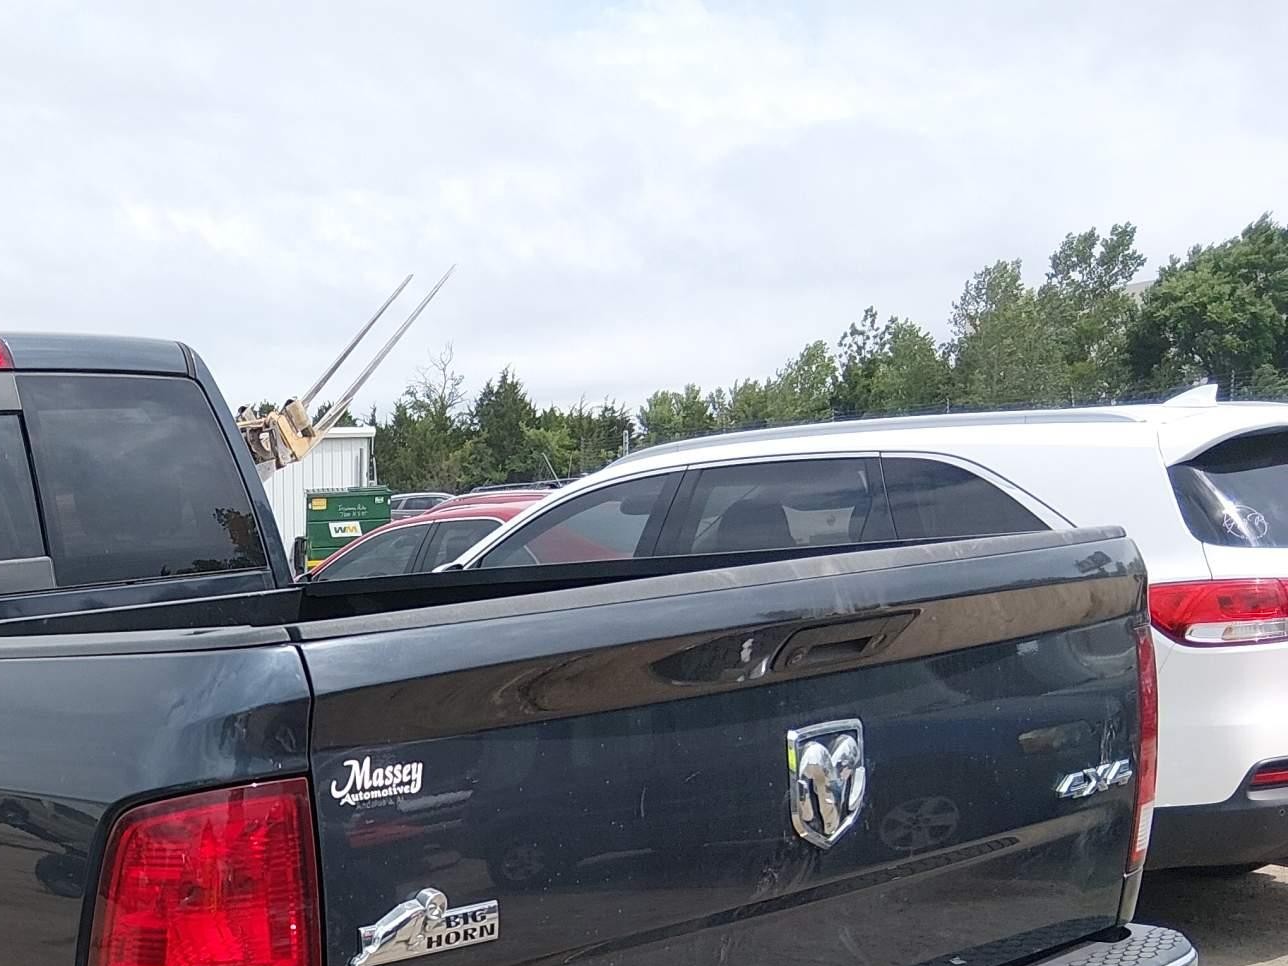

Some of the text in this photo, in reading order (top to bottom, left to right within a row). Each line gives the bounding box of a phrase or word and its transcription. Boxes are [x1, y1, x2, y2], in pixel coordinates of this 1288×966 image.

[331, 756, 423, 799] Massey
[340, 784, 410, 805] Automotive
[446, 908, 487, 929] BIG
[426, 923, 495, 949] HORN
